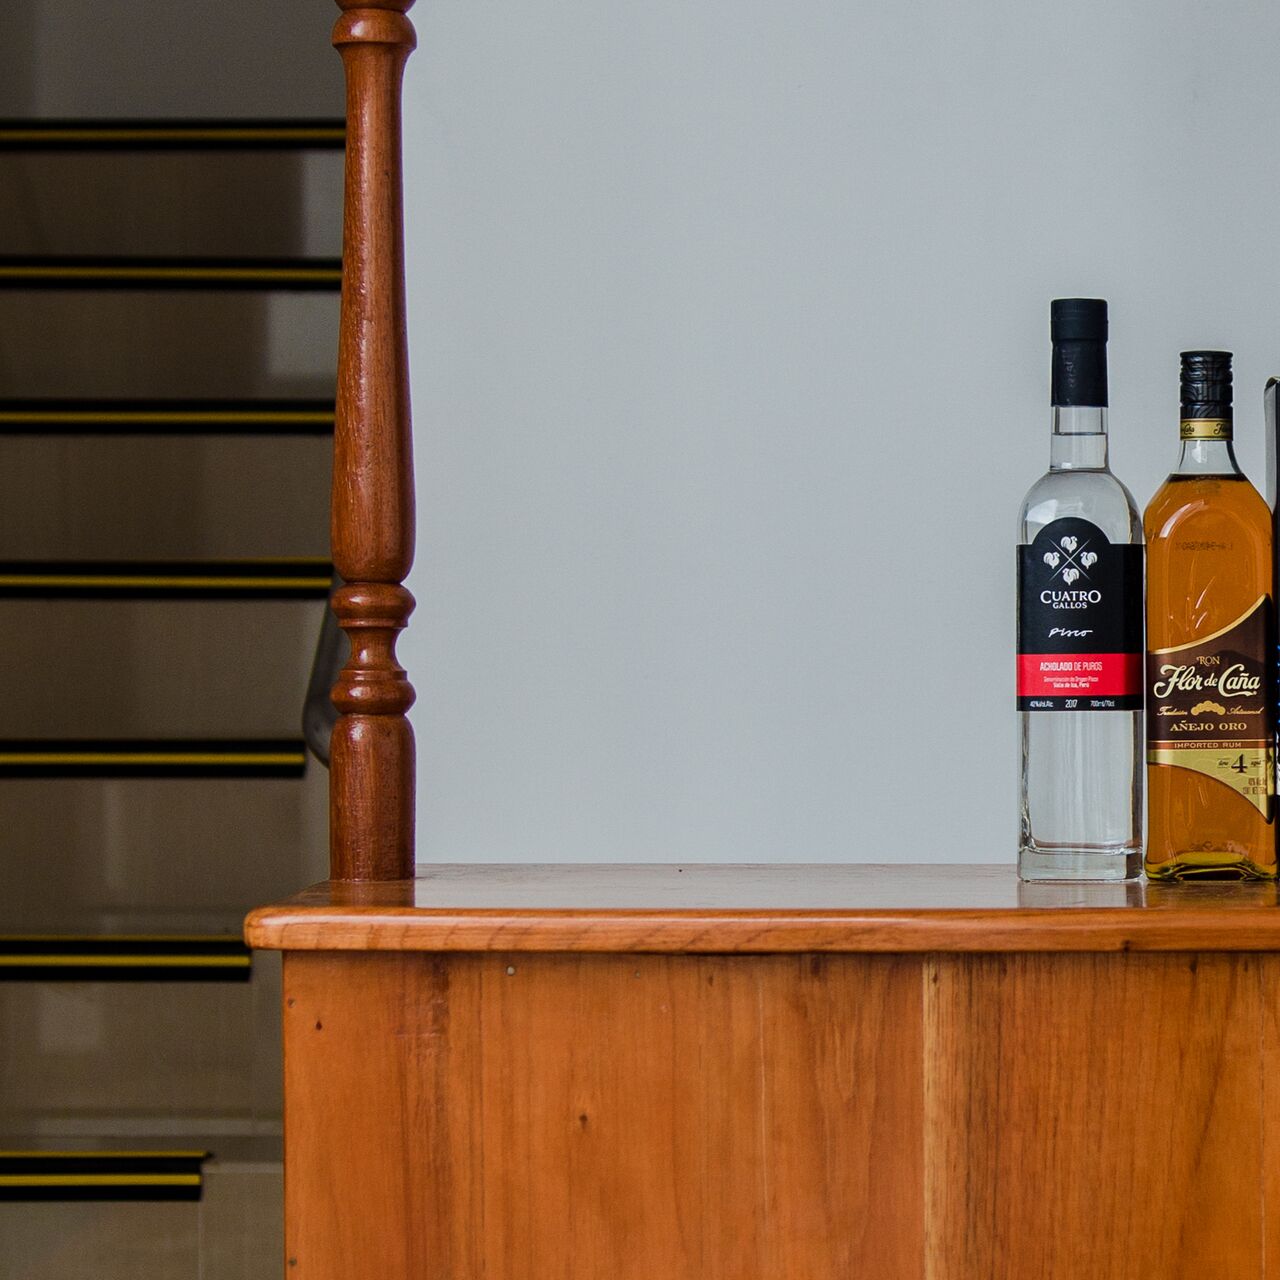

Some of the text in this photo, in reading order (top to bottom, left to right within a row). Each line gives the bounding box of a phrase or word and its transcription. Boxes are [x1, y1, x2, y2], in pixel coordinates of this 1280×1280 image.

[1040, 589, 1101, 604] CUATRO
[1039, 661, 1103, 671] ACHOLADO DE PUROS
[1196, 656, 1220, 667] RON
[1153, 663, 1261, 699] Flor de Caña
[1065, 699, 1078, 708] 2017
[1170, 720, 1247, 731] AÑEJO ORO
[1231, 753, 1248, 773] 4
